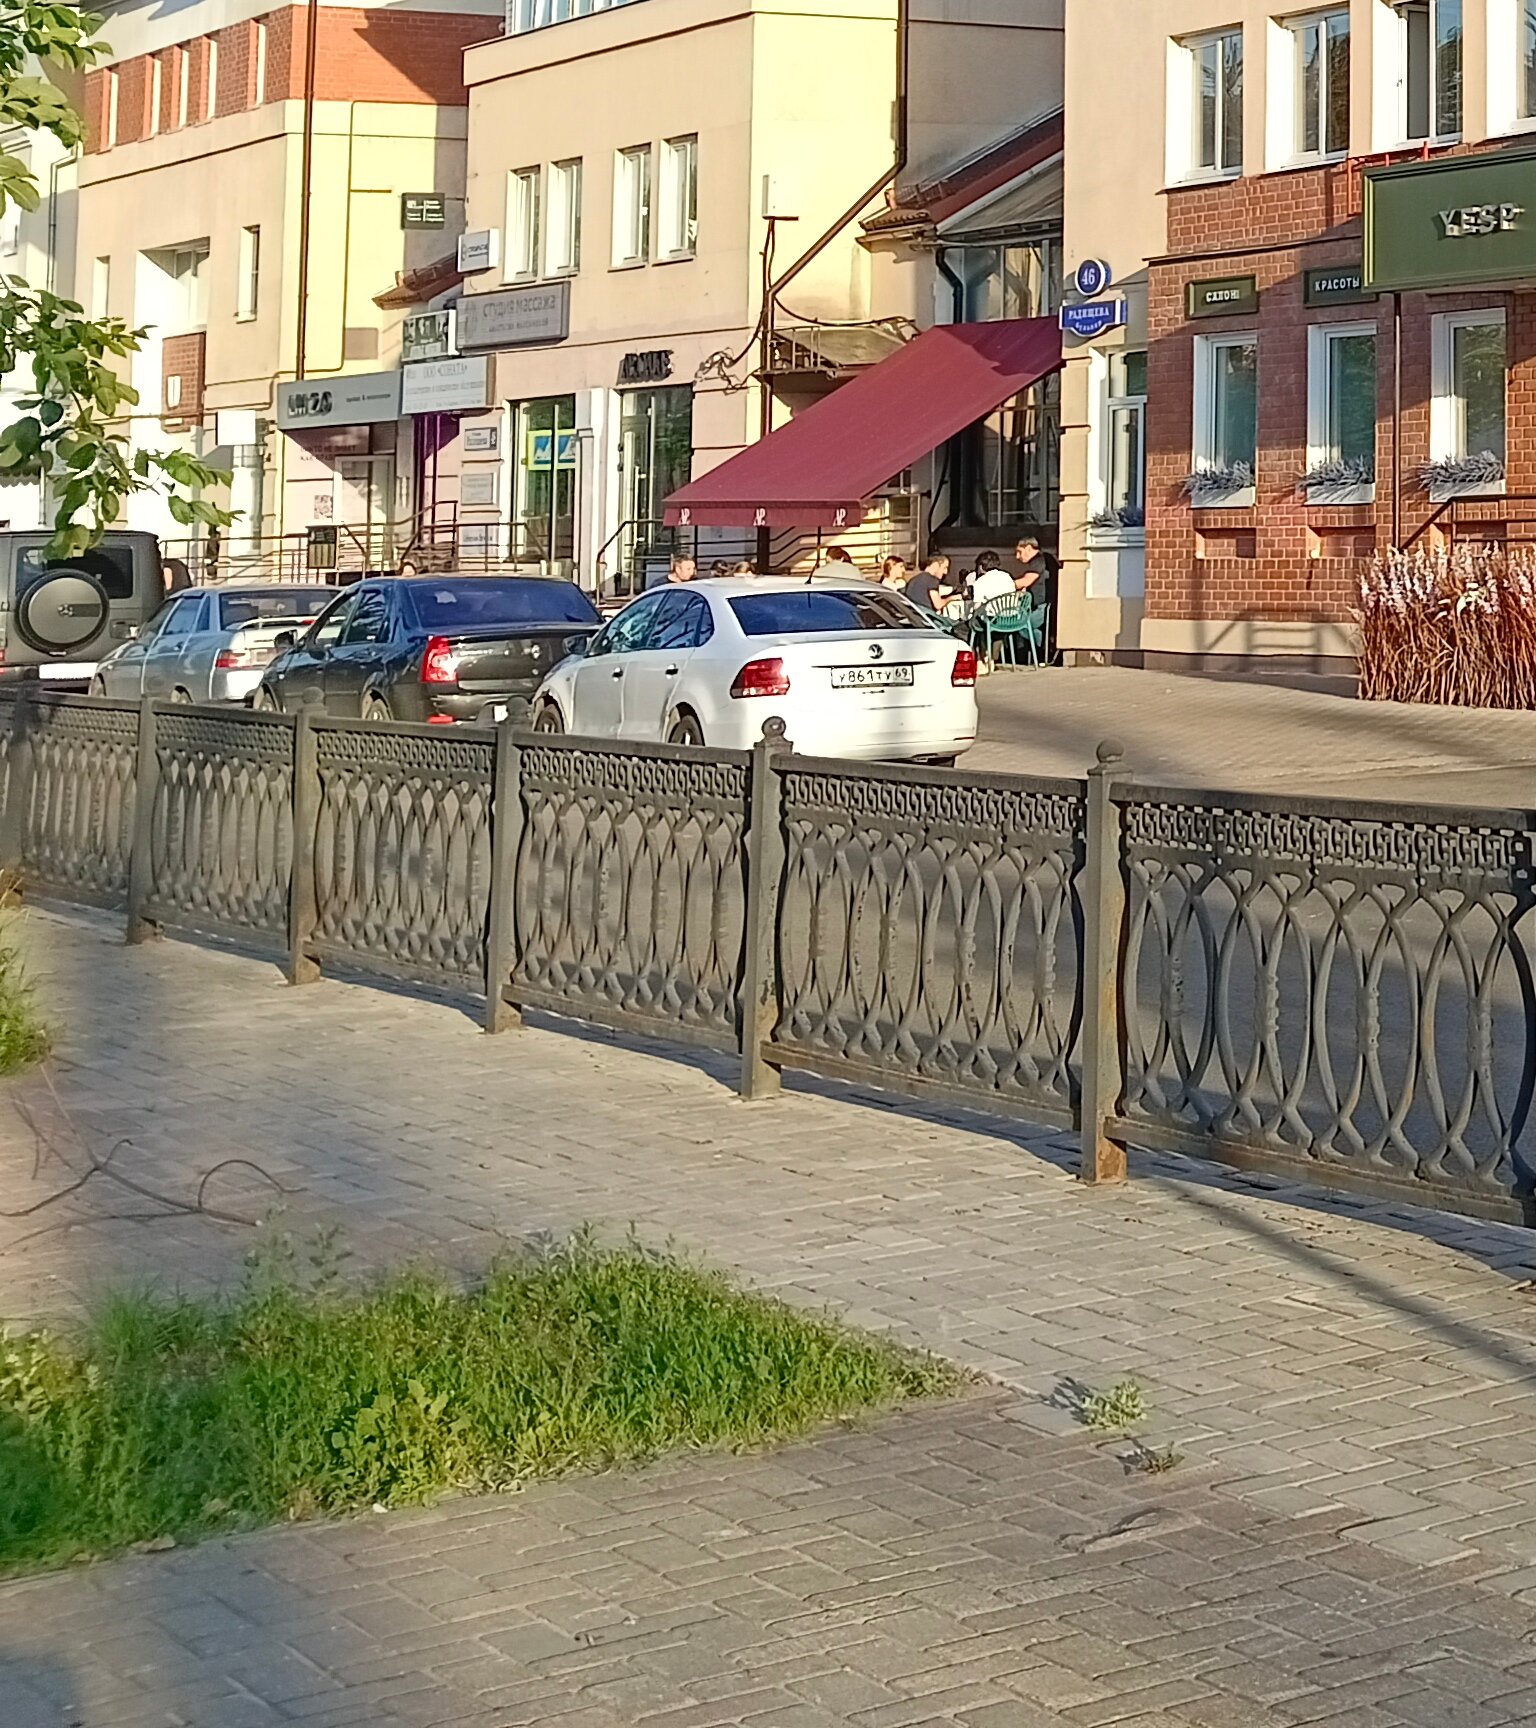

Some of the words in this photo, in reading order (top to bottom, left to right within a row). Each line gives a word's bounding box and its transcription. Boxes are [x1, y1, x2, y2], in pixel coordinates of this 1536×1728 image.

[1434, 202, 1522, 238] YESP
[1081, 268, 1096, 286] 46
[1314, 276, 1360, 292] КРАСОТЫ
[1068, 306, 1110, 320] РАДИЩЕВА
